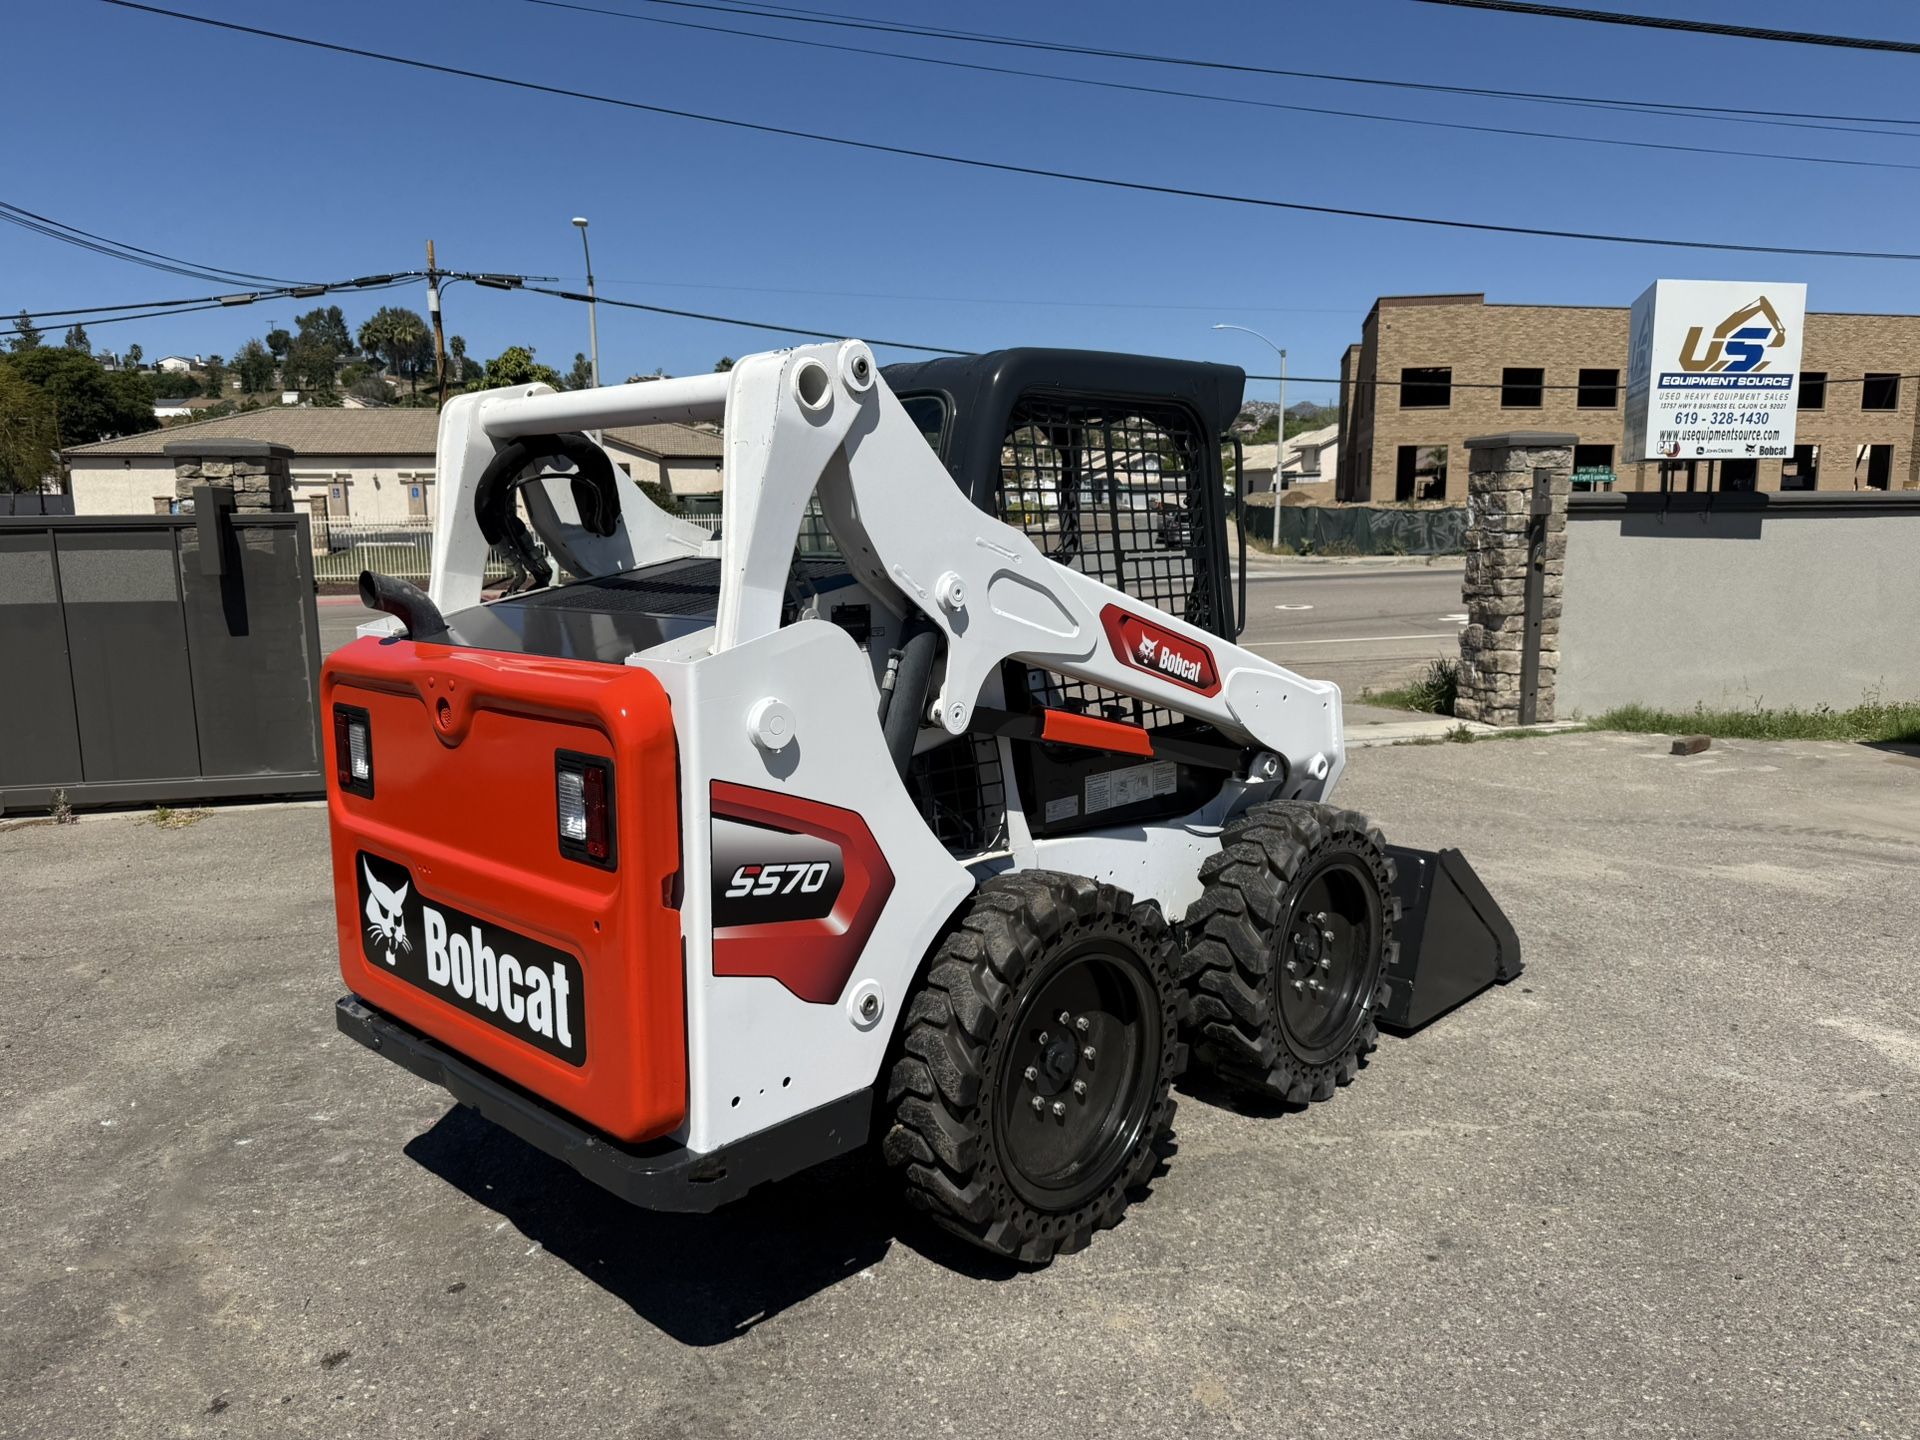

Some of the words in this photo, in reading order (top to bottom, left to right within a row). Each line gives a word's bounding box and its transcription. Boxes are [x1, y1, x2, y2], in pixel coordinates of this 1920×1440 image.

[1679, 327, 1772, 372] US
[1662, 376, 1737, 386] EQUIPMENT
[1737, 376, 1790, 386] SOURCE
[1659, 392, 1681, 401] USED
[1684, 392, 1710, 401] HEAVY
[1714, 392, 1761, 401] EQUIPMENT
[1764, 392, 1790, 401] SALES
[1675, 412, 1698, 425] 619
[1710, 412, 1770, 425] 328-1430
[1659, 427, 1780, 444] www.usequipmentsource.com
[1657, 441, 1676, 455] CAT
[1759, 445, 1787, 456] Bobcat
[1159, 646, 1201, 683] Bobcat
[725, 862, 830, 898] S570
[423, 905, 572, 1048] Bobcat
